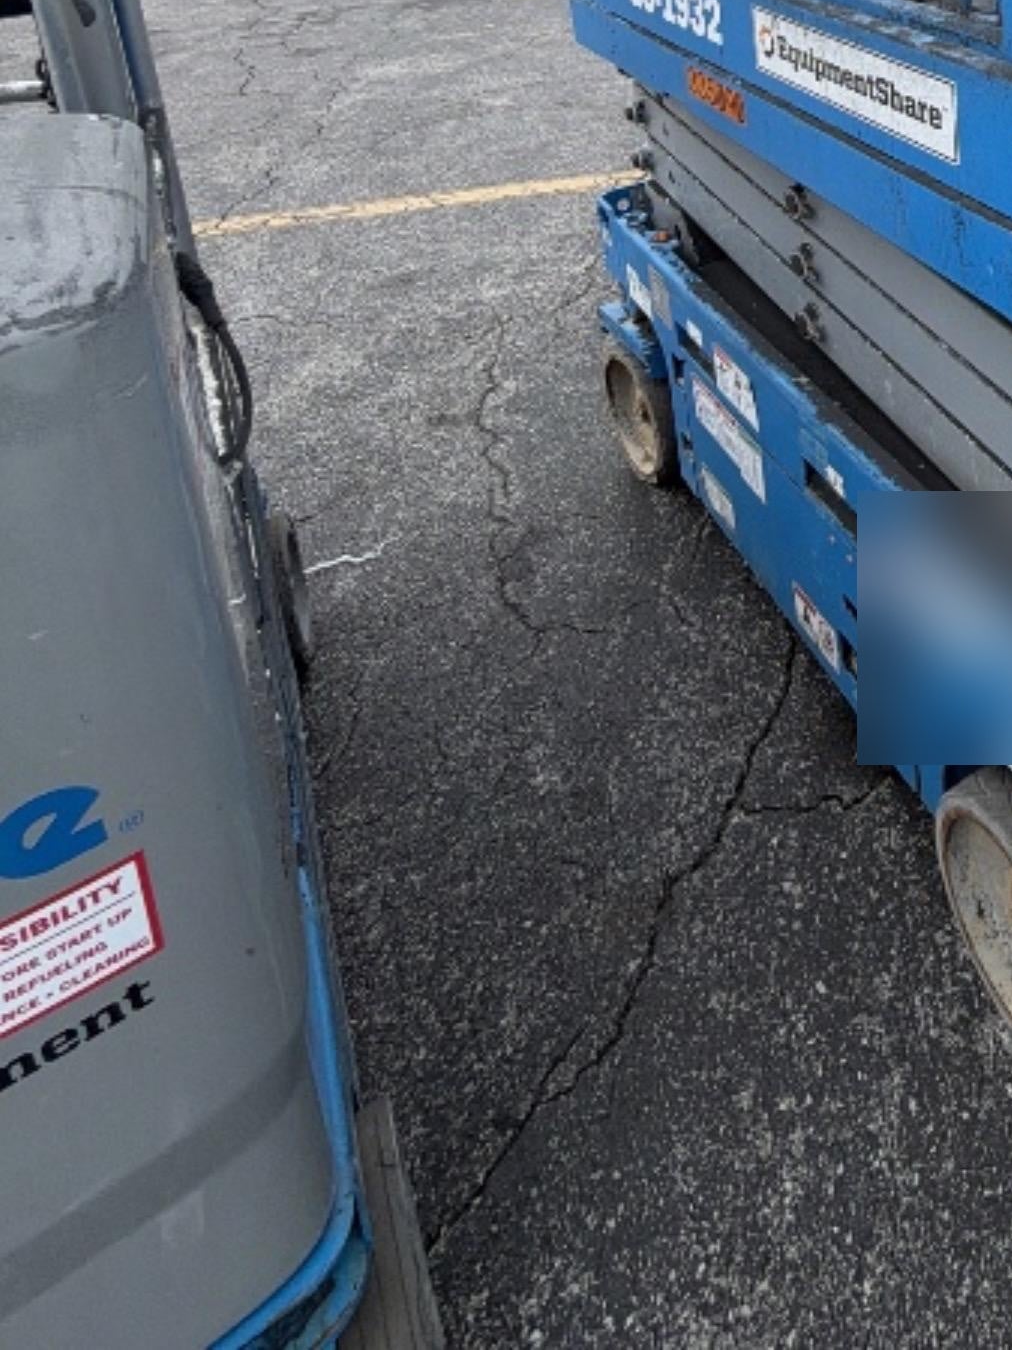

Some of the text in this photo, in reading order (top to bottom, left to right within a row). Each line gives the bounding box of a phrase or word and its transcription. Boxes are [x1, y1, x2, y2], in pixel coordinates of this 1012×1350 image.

[776, 35, 943, 130] EquipmentShare
[0, 876, 122, 951] SIBILITY
[47, 924, 103, 960] START
[107, 907, 133, 928] UP
[3, 942, 108, 1002] REFUELING
[59, 936, 150, 992] CLEANING
